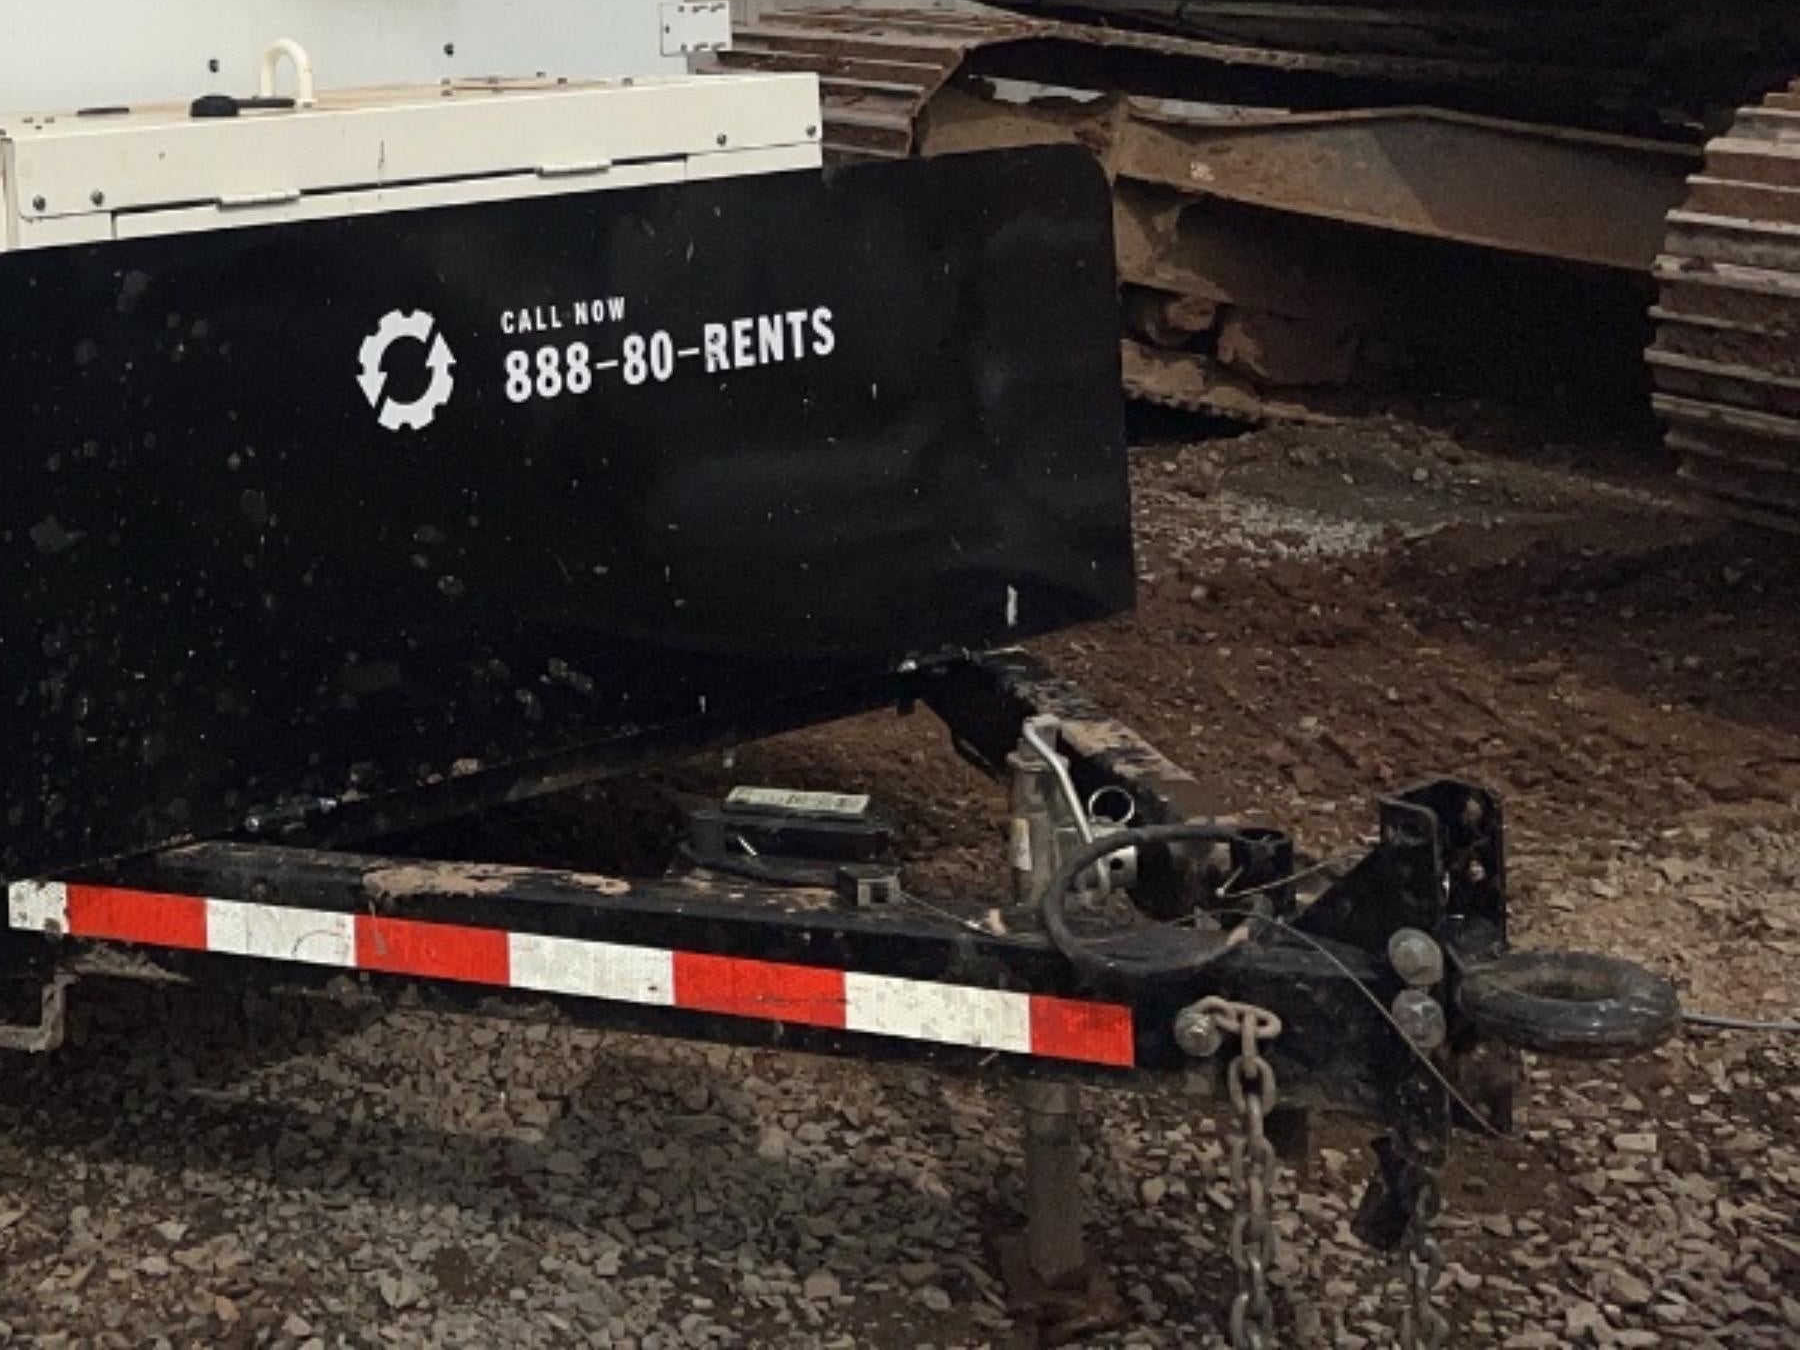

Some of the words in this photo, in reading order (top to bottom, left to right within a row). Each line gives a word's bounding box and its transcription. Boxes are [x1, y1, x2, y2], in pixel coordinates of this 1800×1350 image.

[500, 305, 563, 334] CALL
[574, 296, 626, 326] NOW
[504, 305, 836, 403] 888-80-RENTS
